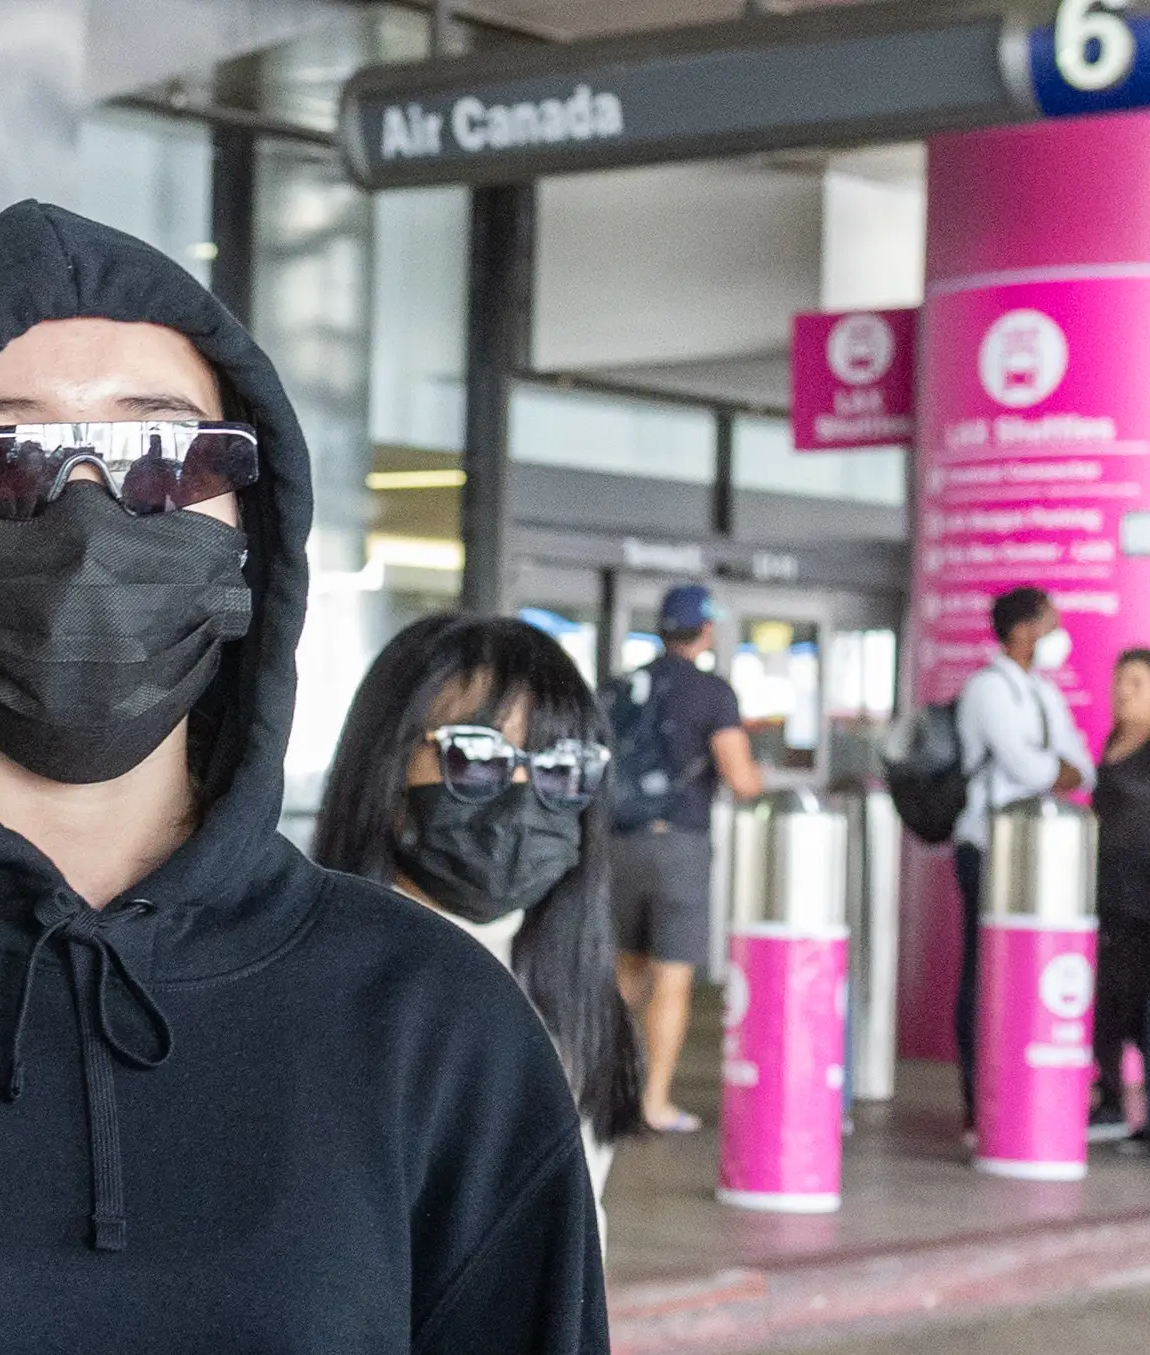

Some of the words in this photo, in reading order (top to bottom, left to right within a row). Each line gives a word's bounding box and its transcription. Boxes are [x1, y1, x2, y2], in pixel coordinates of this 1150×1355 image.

[1054, 0, 1135, 90] 6
[382, 103, 442, 159] Air
[452, 83, 623, 152] Canada
